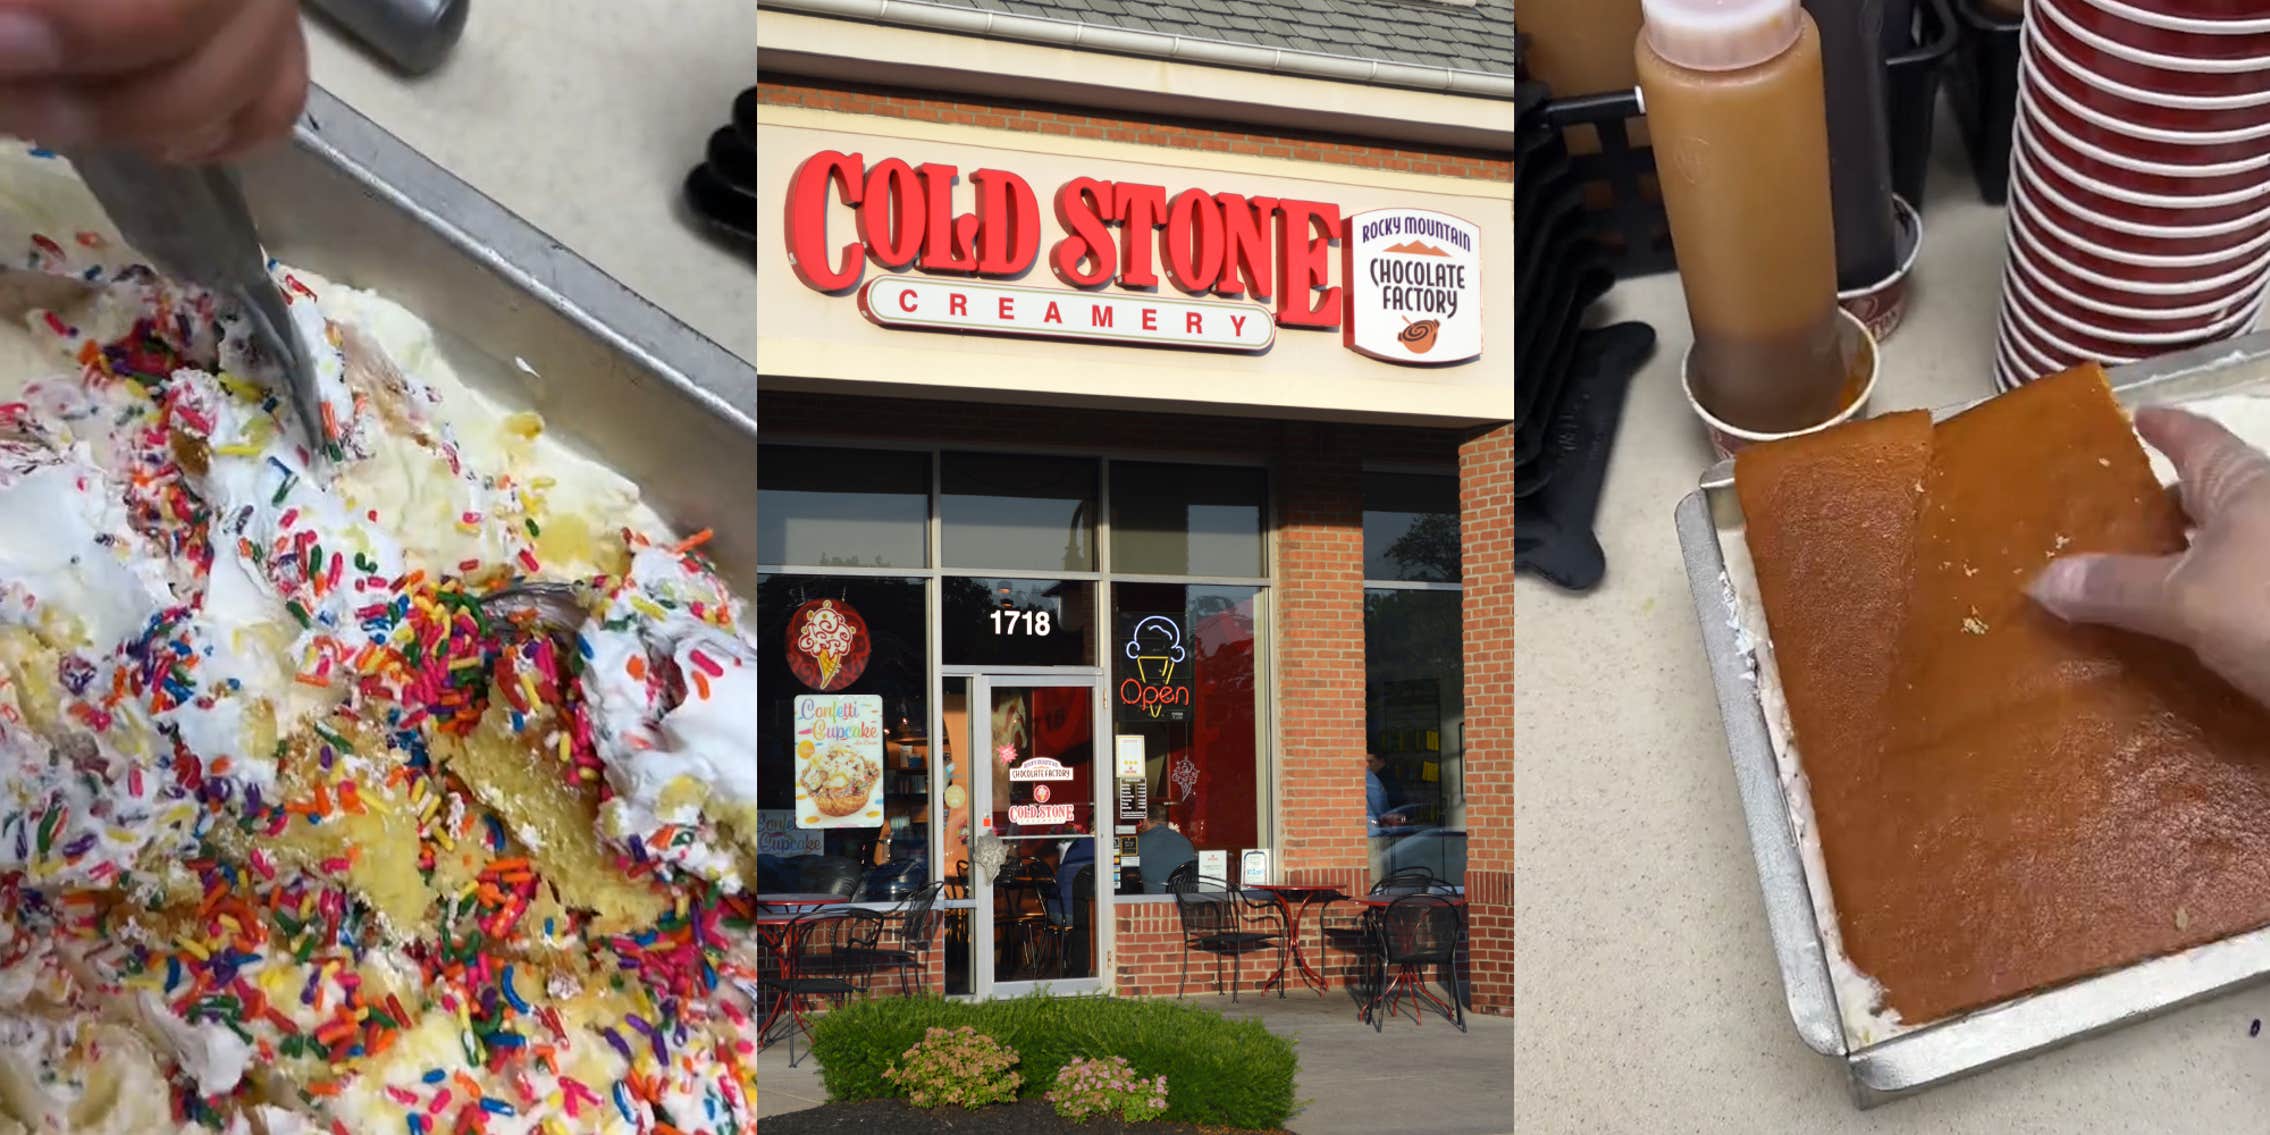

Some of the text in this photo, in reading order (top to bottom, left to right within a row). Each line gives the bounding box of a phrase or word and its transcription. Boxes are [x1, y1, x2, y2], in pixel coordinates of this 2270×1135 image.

[784, 149, 1342, 328] COLD STONE
[1362, 216, 1471, 252] ROCKY MOUNTAIN
[1370, 258, 1465, 289] CHOCOLATE
[899, 288, 1246, 337] CREAMERY
[1383, 285, 1458, 319] FACTORY
[990, 609, 1051, 637] 1718
[1120, 677, 1190, 711] Open
[800, 698, 860, 724] Confetti
[812, 719, 878, 741] Cupcake
[1009, 805, 1074, 823] COLD STONE
